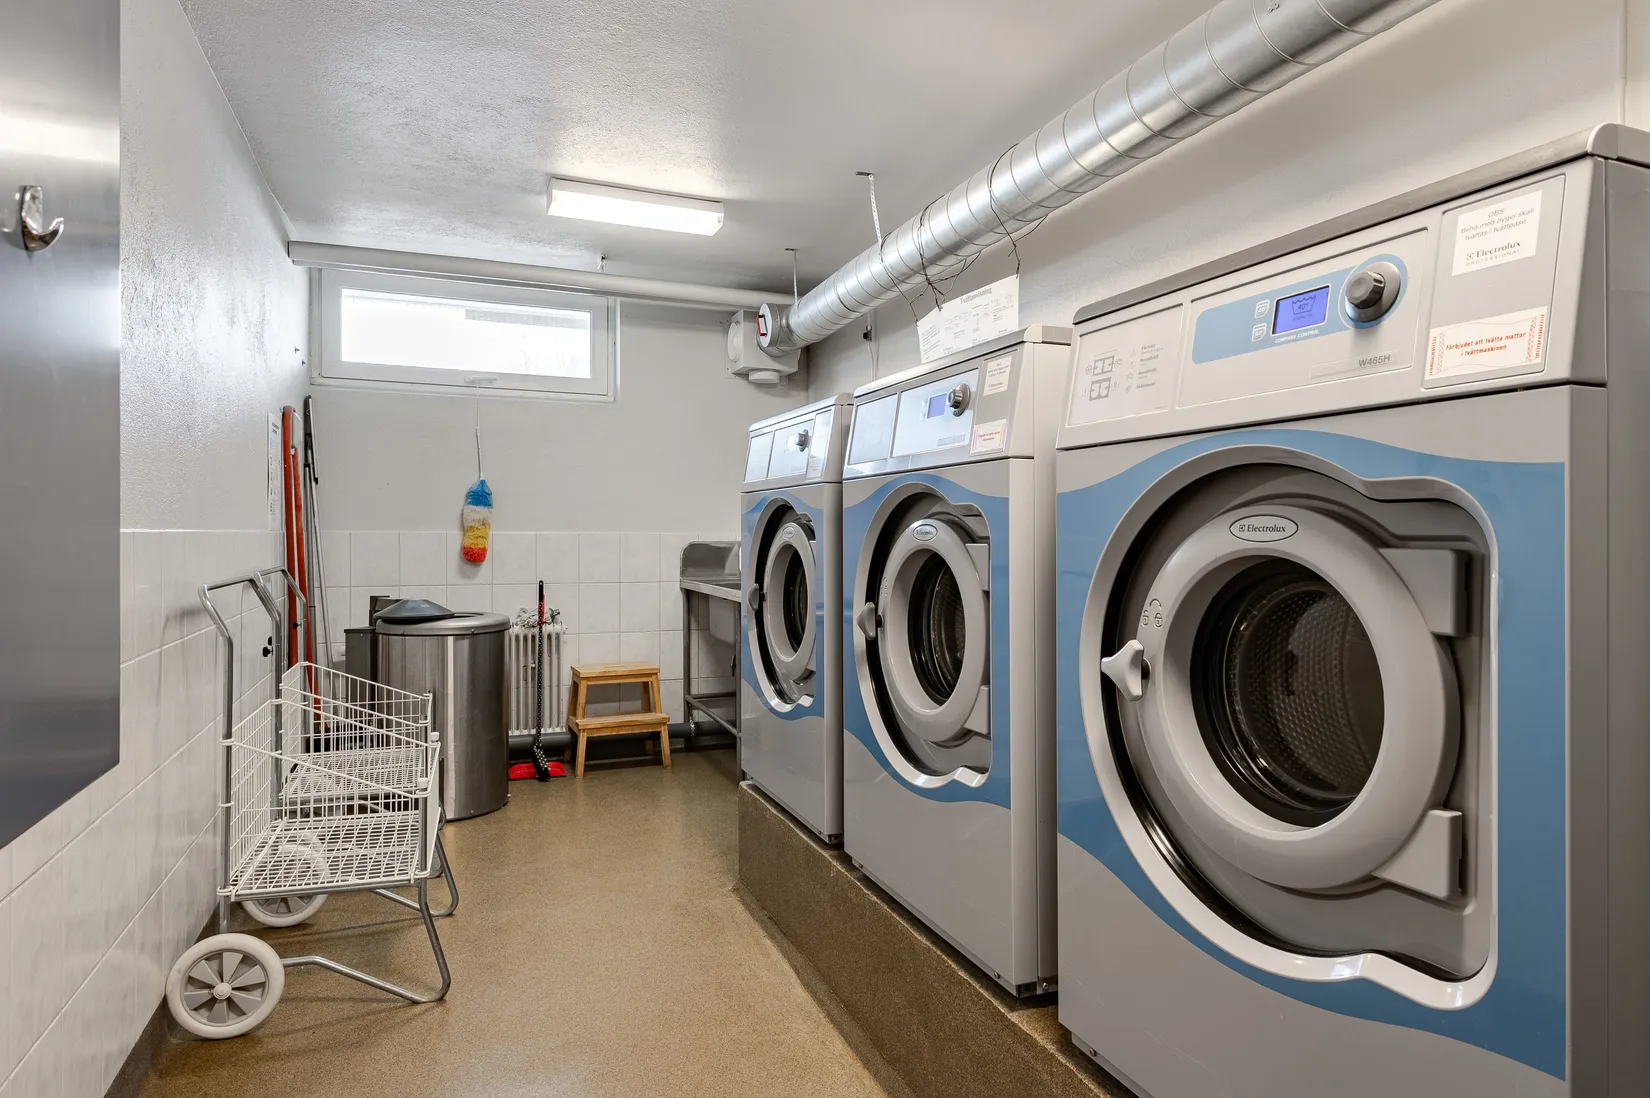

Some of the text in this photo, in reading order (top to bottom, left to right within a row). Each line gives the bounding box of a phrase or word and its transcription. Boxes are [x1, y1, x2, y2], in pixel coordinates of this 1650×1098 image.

[1476, 241, 1521, 258] Electrolux
[1465, 249, 1520, 266] PROFESSIONAL
[1297, 329, 1319, 338] CONTROL
[1485, 336, 1503, 344] tvätta
[1504, 332, 1527, 340] mattor
[1358, 353, 1391, 367] W465H
[1246, 524, 1286, 533] Electrolux
